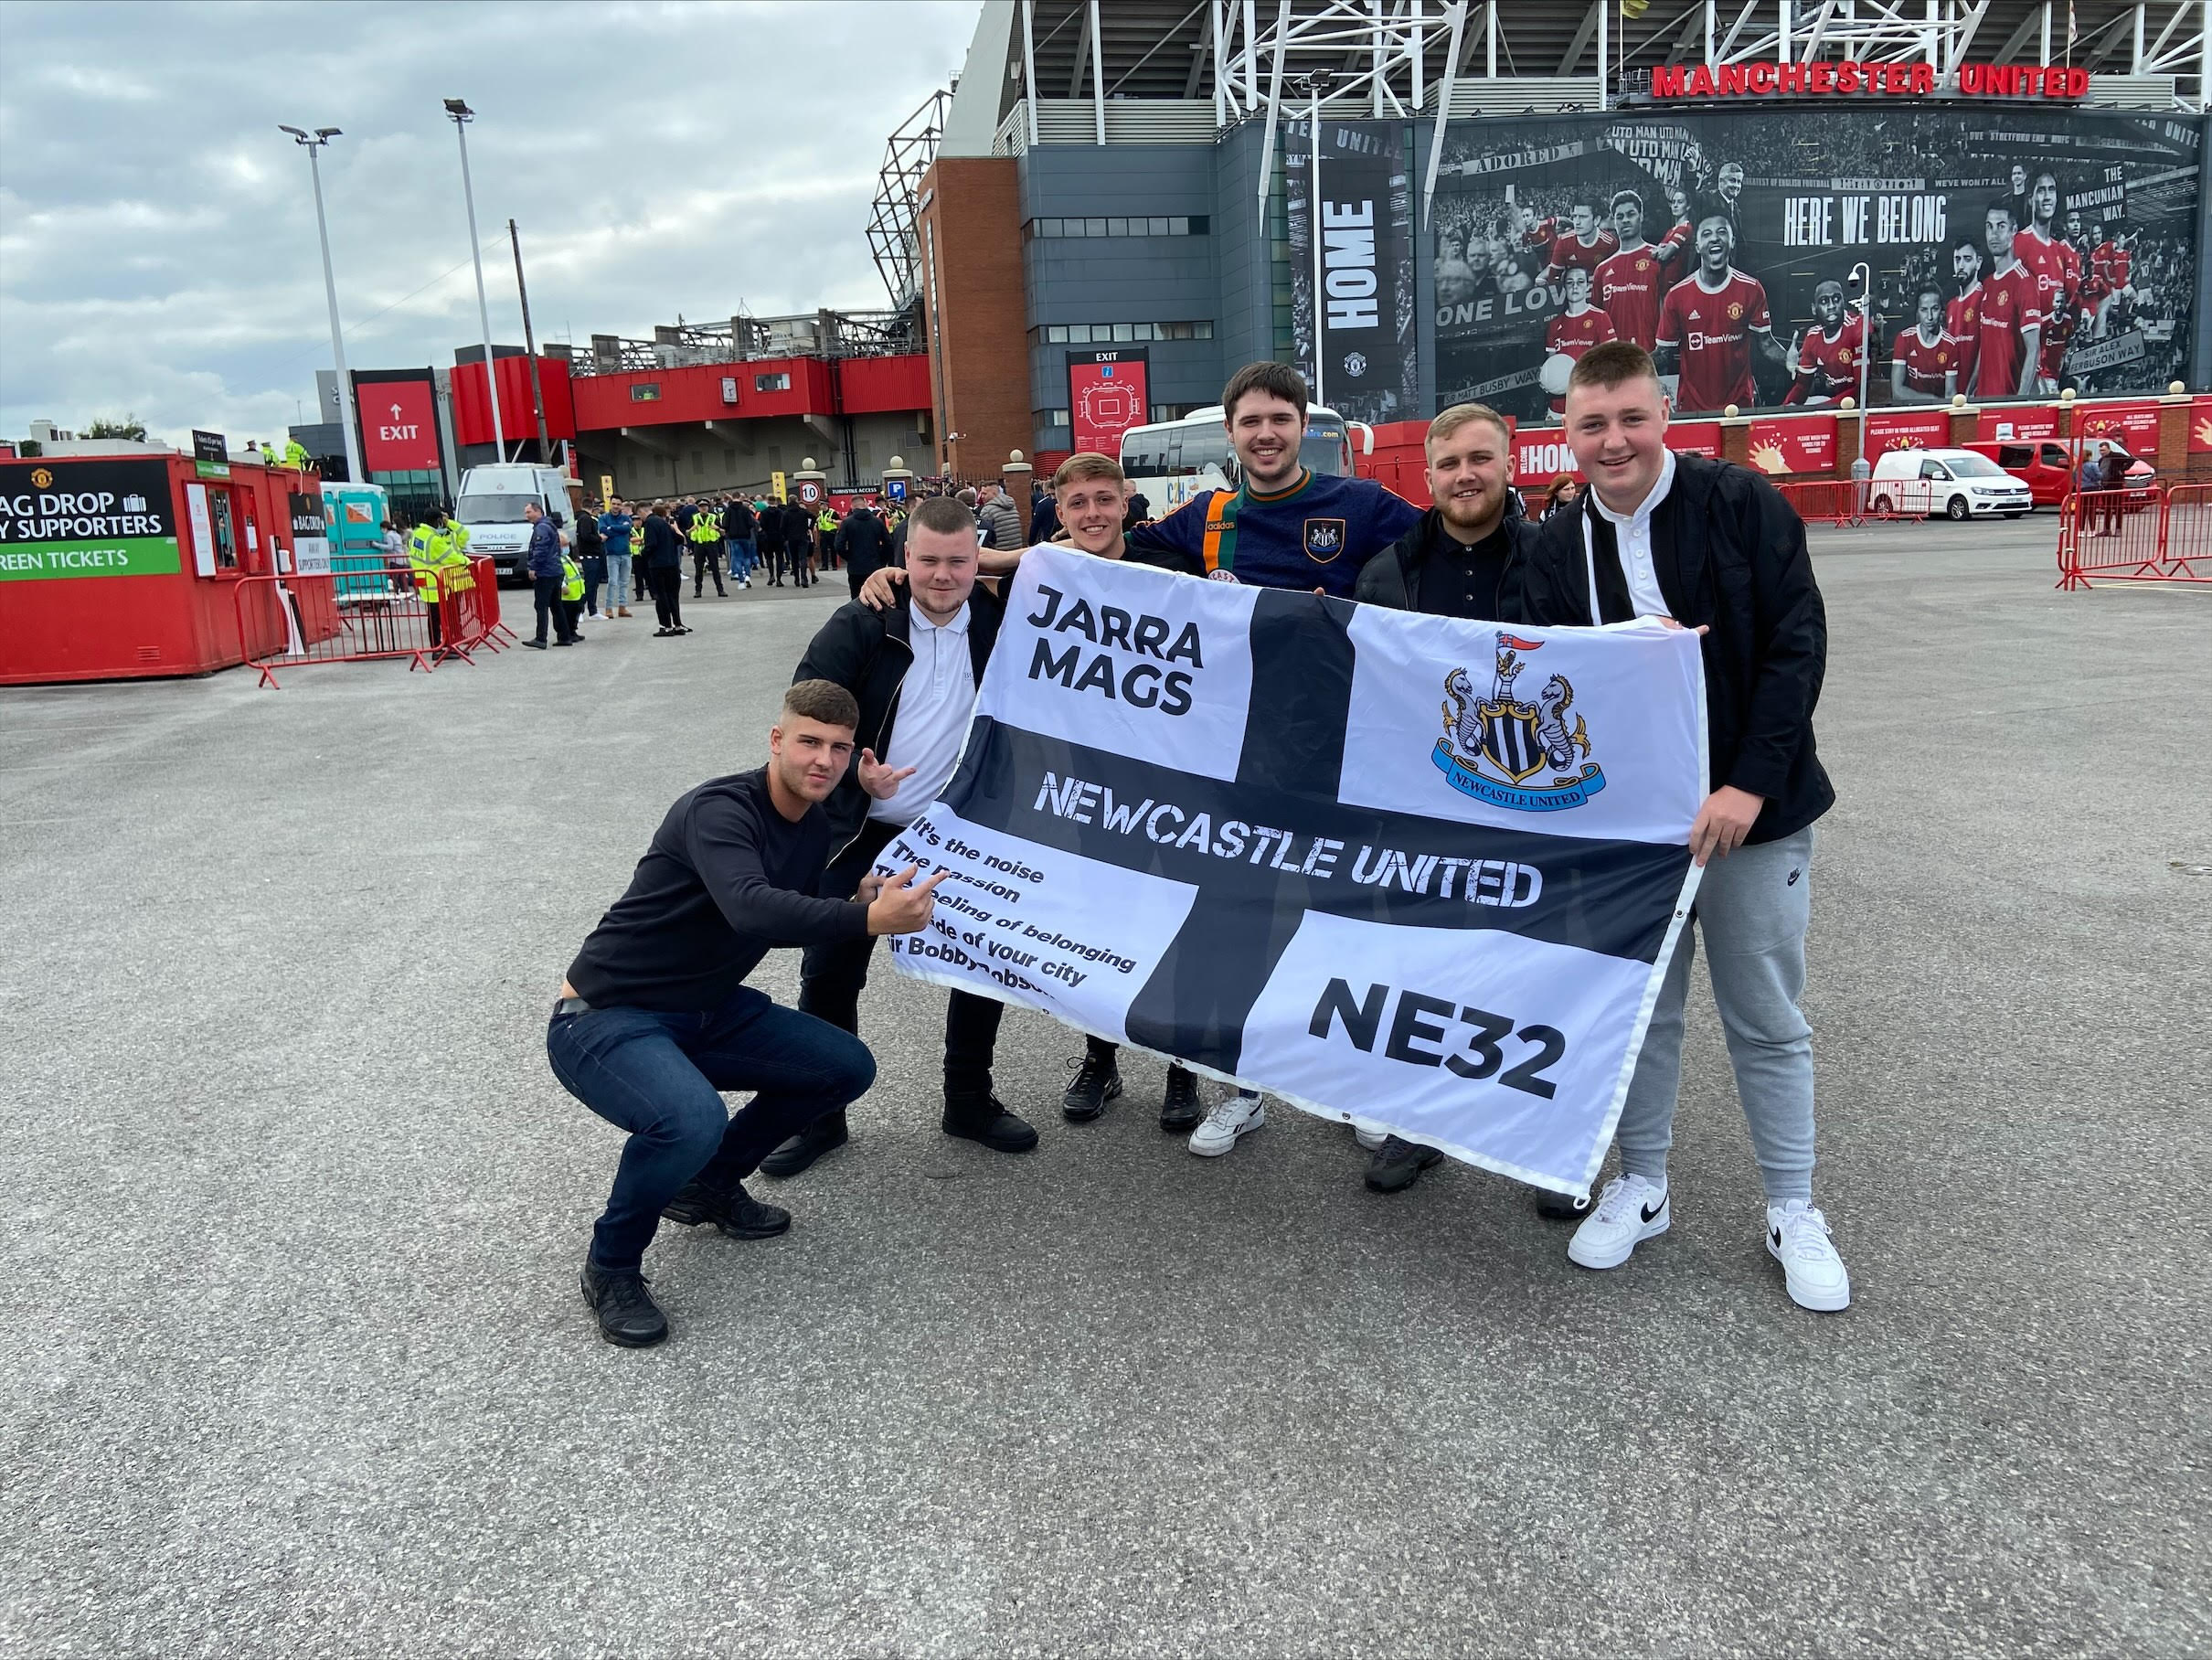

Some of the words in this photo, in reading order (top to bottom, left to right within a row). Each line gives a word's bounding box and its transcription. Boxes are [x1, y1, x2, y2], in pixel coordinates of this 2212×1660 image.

[1653, 61, 1934, 97] MANCHESTER
[1960, 63, 2090, 98] UNITED
[1635, 125, 1657, 139] MAN
[1476, 147, 1559, 173] ADORED
[1629, 139, 1659, 158] UTD
[2104, 165, 2123, 183] THE
[2066, 185, 2124, 210] MANCUNIAN
[1783, 197, 1834, 247] HERE
[1842, 196, 1870, 245] WE
[1877, 195, 1947, 244] BELONG
[2102, 204, 2126, 222] WAY.
[1323, 200, 1379, 330] HOME
[1435, 299, 1494, 327] ONE
[1560, 338, 1595, 348] TeamViewer
[2084, 348, 2098, 358] SIR
[2100, 340, 2122, 354] ALEX
[1096, 352, 1119, 362] EXIT
[2070, 352, 2115, 373] FERGUSON
[2118, 344, 2141, 358] WAY
[1457, 388, 1478, 400] MATT
[1480, 378, 1511, 395] BUSBY
[1515, 367, 1539, 385] WAY
[379, 425, 419, 441] EXIT
[1520, 445, 1528, 475] WELCOME
[1528, 443, 1580, 474] HOM
[803, 487, 816, 498] 10
[892, 484, 902, 493] P
[38, 492, 115, 516] DROP
[16, 515, 163, 539] SUPPORTERS
[298, 515, 310, 531] BAG
[1207, 521, 1235, 530] adidas
[47, 549, 129, 569] TICKETS
[1026, 583, 1205, 670] JARRA
[1027, 637, 1194, 717] MAGS
[1452, 771, 1527, 806] NEWCASTLE
[1529, 792, 1580, 807] UNITED
[911, 816, 941, 846] It's
[944, 837, 981, 860] the
[984, 855, 1045, 884] noise
[1033, 771, 1345, 878] NEWCASTLE
[1350, 844, 1544, 909] UNITED
[891, 839, 931, 869] The
[888, 934, 903, 953] ir
[931, 889, 993, 922] eeling
[995, 919, 1025, 931] of
[1022, 924, 1137, 974] belonging
[962, 931, 986, 949] of
[988, 940, 1039, 968] your
[1041, 962, 1089, 988] city
[1308, 977, 1567, 1101] NE32
